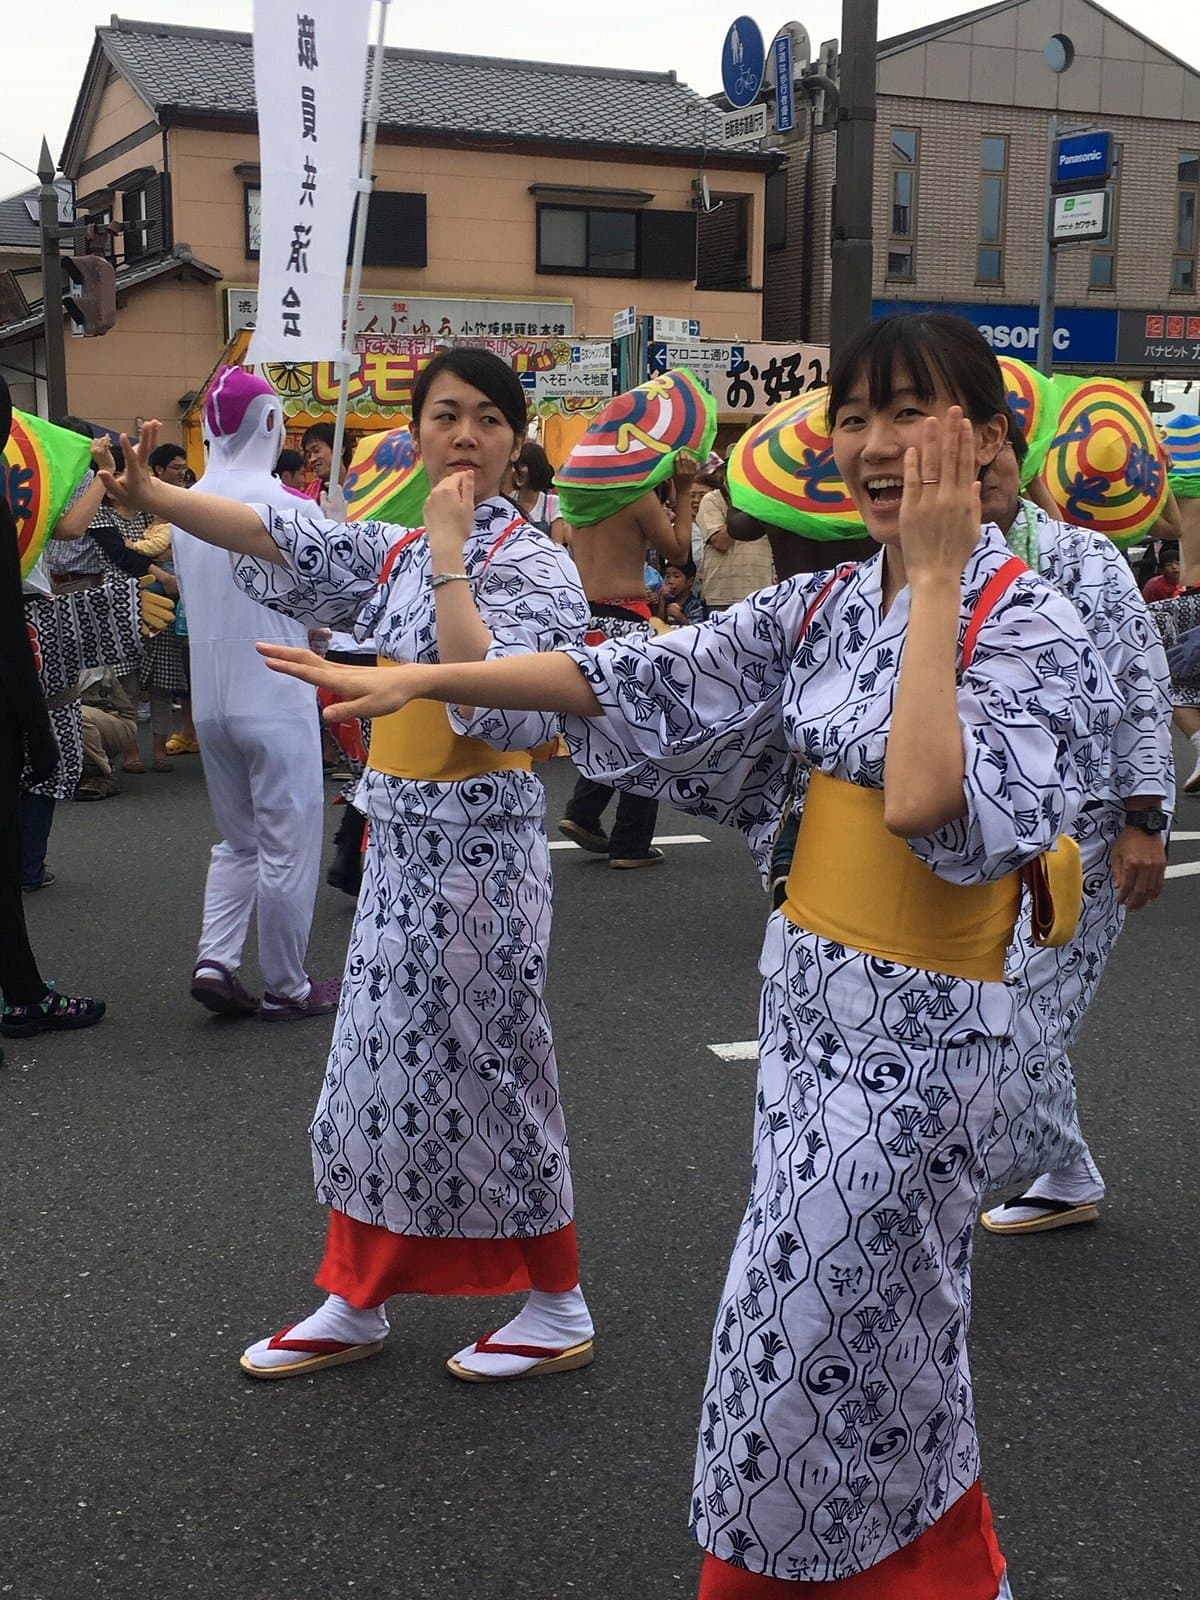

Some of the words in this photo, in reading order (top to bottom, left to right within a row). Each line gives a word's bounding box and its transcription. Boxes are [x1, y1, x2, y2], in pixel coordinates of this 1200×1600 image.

[1059, 149, 1102, 165] Panasonic
[668, 346, 730, 361] マロニエ通り
